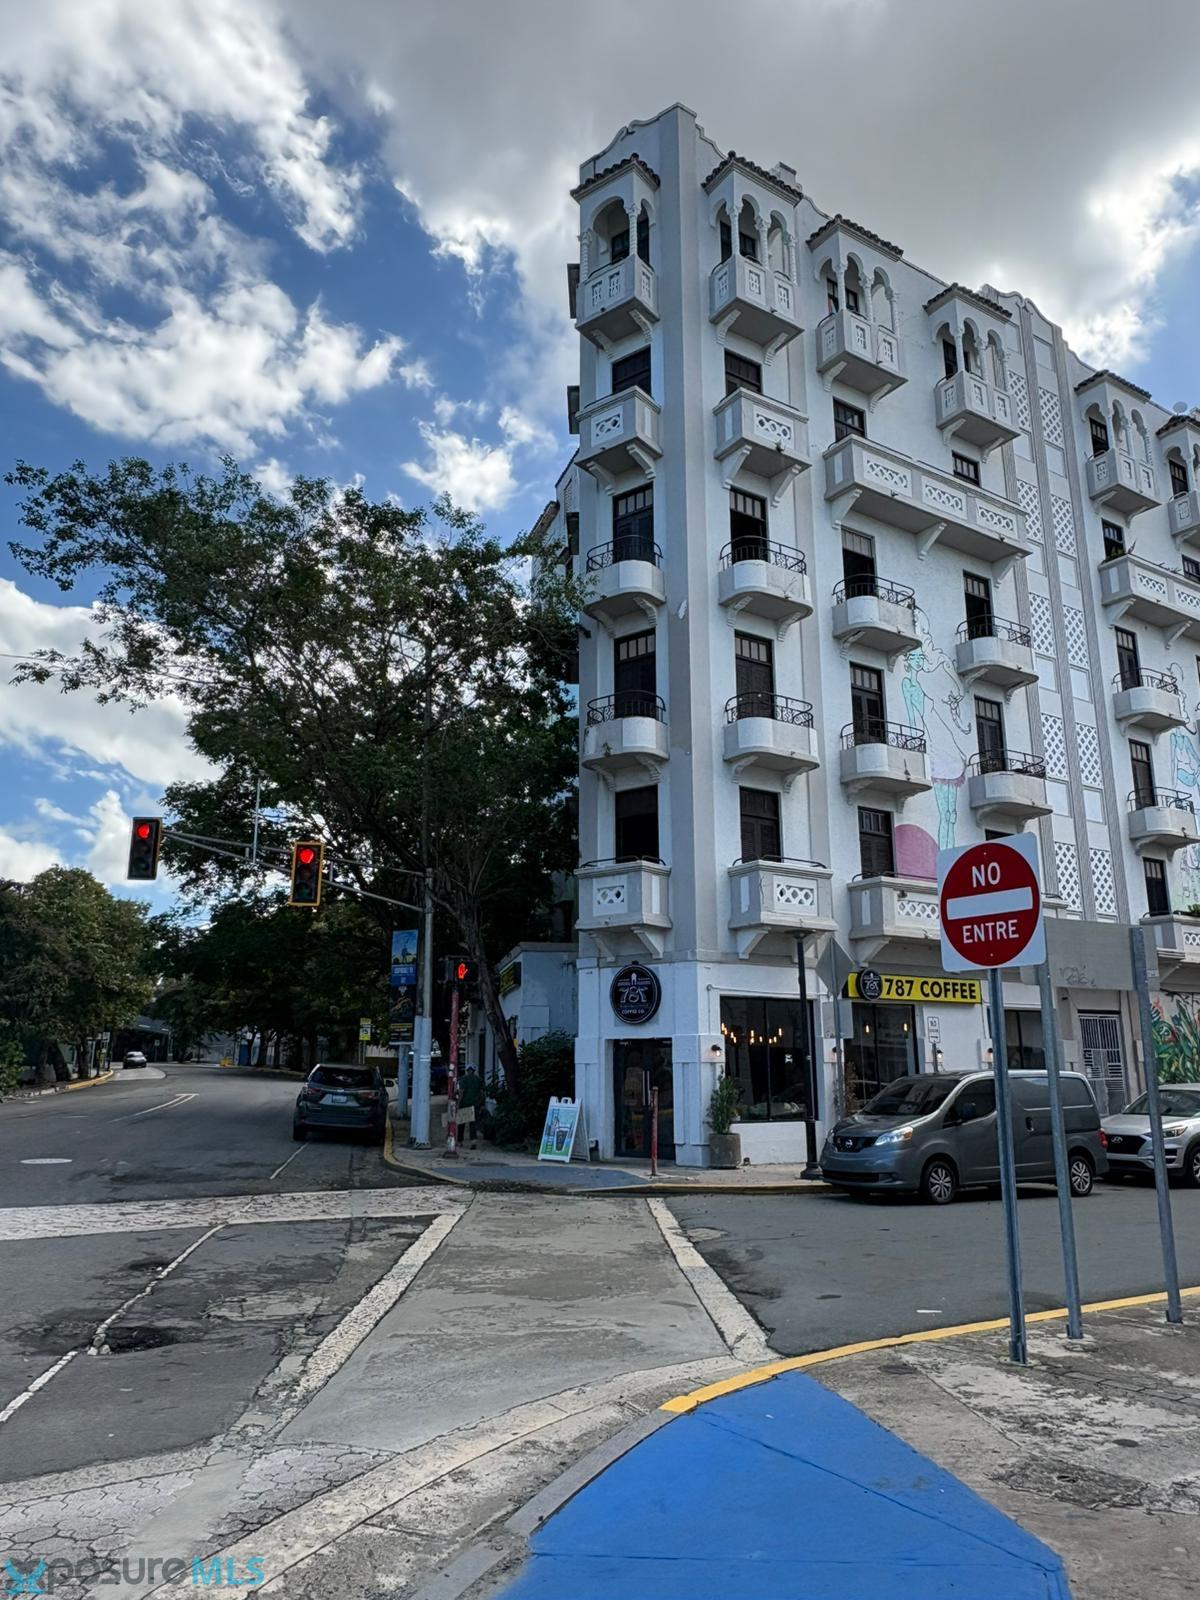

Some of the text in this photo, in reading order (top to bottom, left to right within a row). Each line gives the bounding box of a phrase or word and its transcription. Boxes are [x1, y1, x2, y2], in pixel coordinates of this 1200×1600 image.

[972, 862, 1001, 888] NO
[963, 920, 1019, 944] ENTRE
[884, 978, 977, 1000] 787 COFFEE
